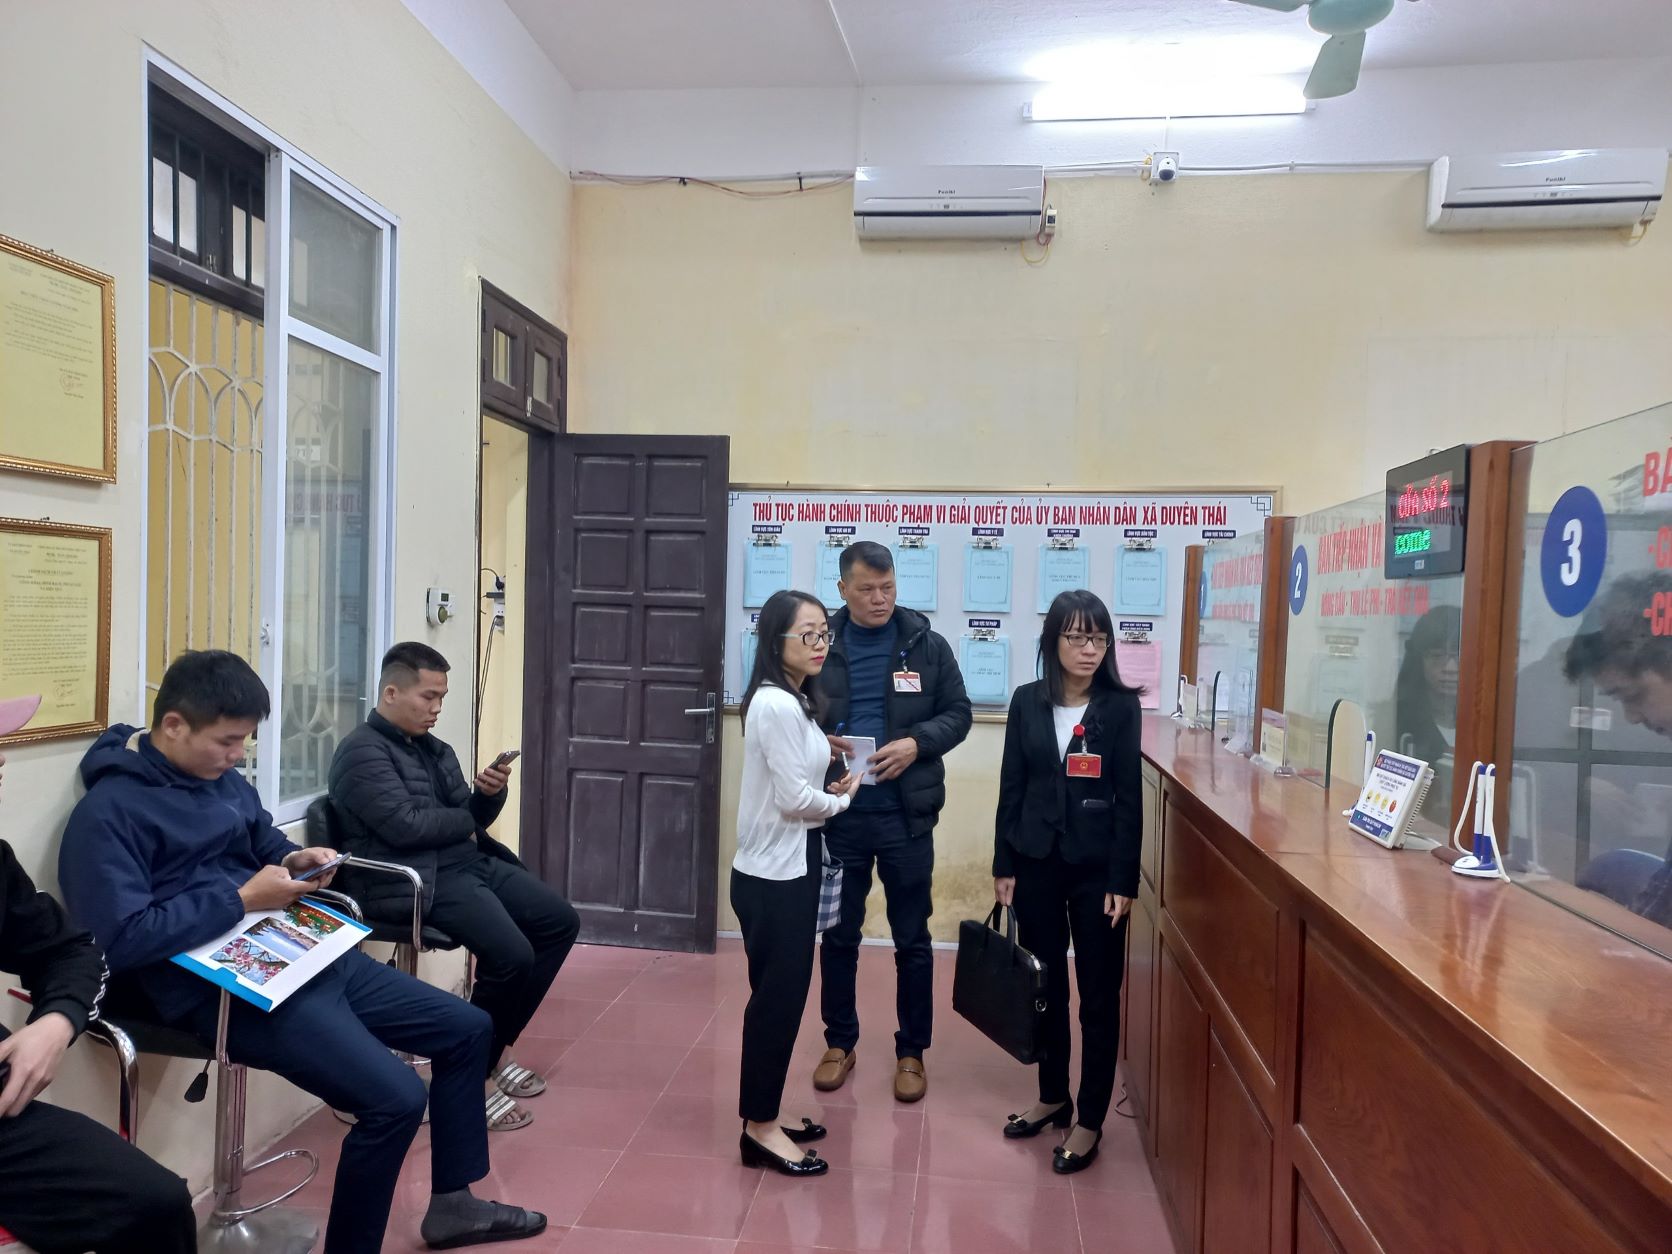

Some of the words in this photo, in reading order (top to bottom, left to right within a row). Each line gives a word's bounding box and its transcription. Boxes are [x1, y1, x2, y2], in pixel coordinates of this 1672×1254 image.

[1440, 480, 1449, 508] 2
[753, 496, 772, 522] THỦ
[775, 503, 794, 526] TỤC
[797, 499, 826, 522] HÀNH
[829, 499, 861, 523] CHÍNH
[865, 499, 898, 527] THUỘC
[901, 505, 933, 528] PHẠM
[936, 505, 946, 524] VI
[949, 498, 971, 525] GIẢI
[974, 500, 1008, 527] QUYẾT
[1011, 498, 1033, 525] CỦA
[1036, 498, 1050, 525] ỦY
[1053, 505, 1076, 525] BAN
[1079, 501, 1111, 525] NHÂN
[1114, 501, 1137, 525] DÂN
[1142, 502, 1157, 525] XÃ
[1160, 501, 1198, 526] DUYÊN
[1202, 501, 1227, 526] THÁI
[1560, 518, 1583, 587] 3
[1294, 562, 1302, 599] 2
